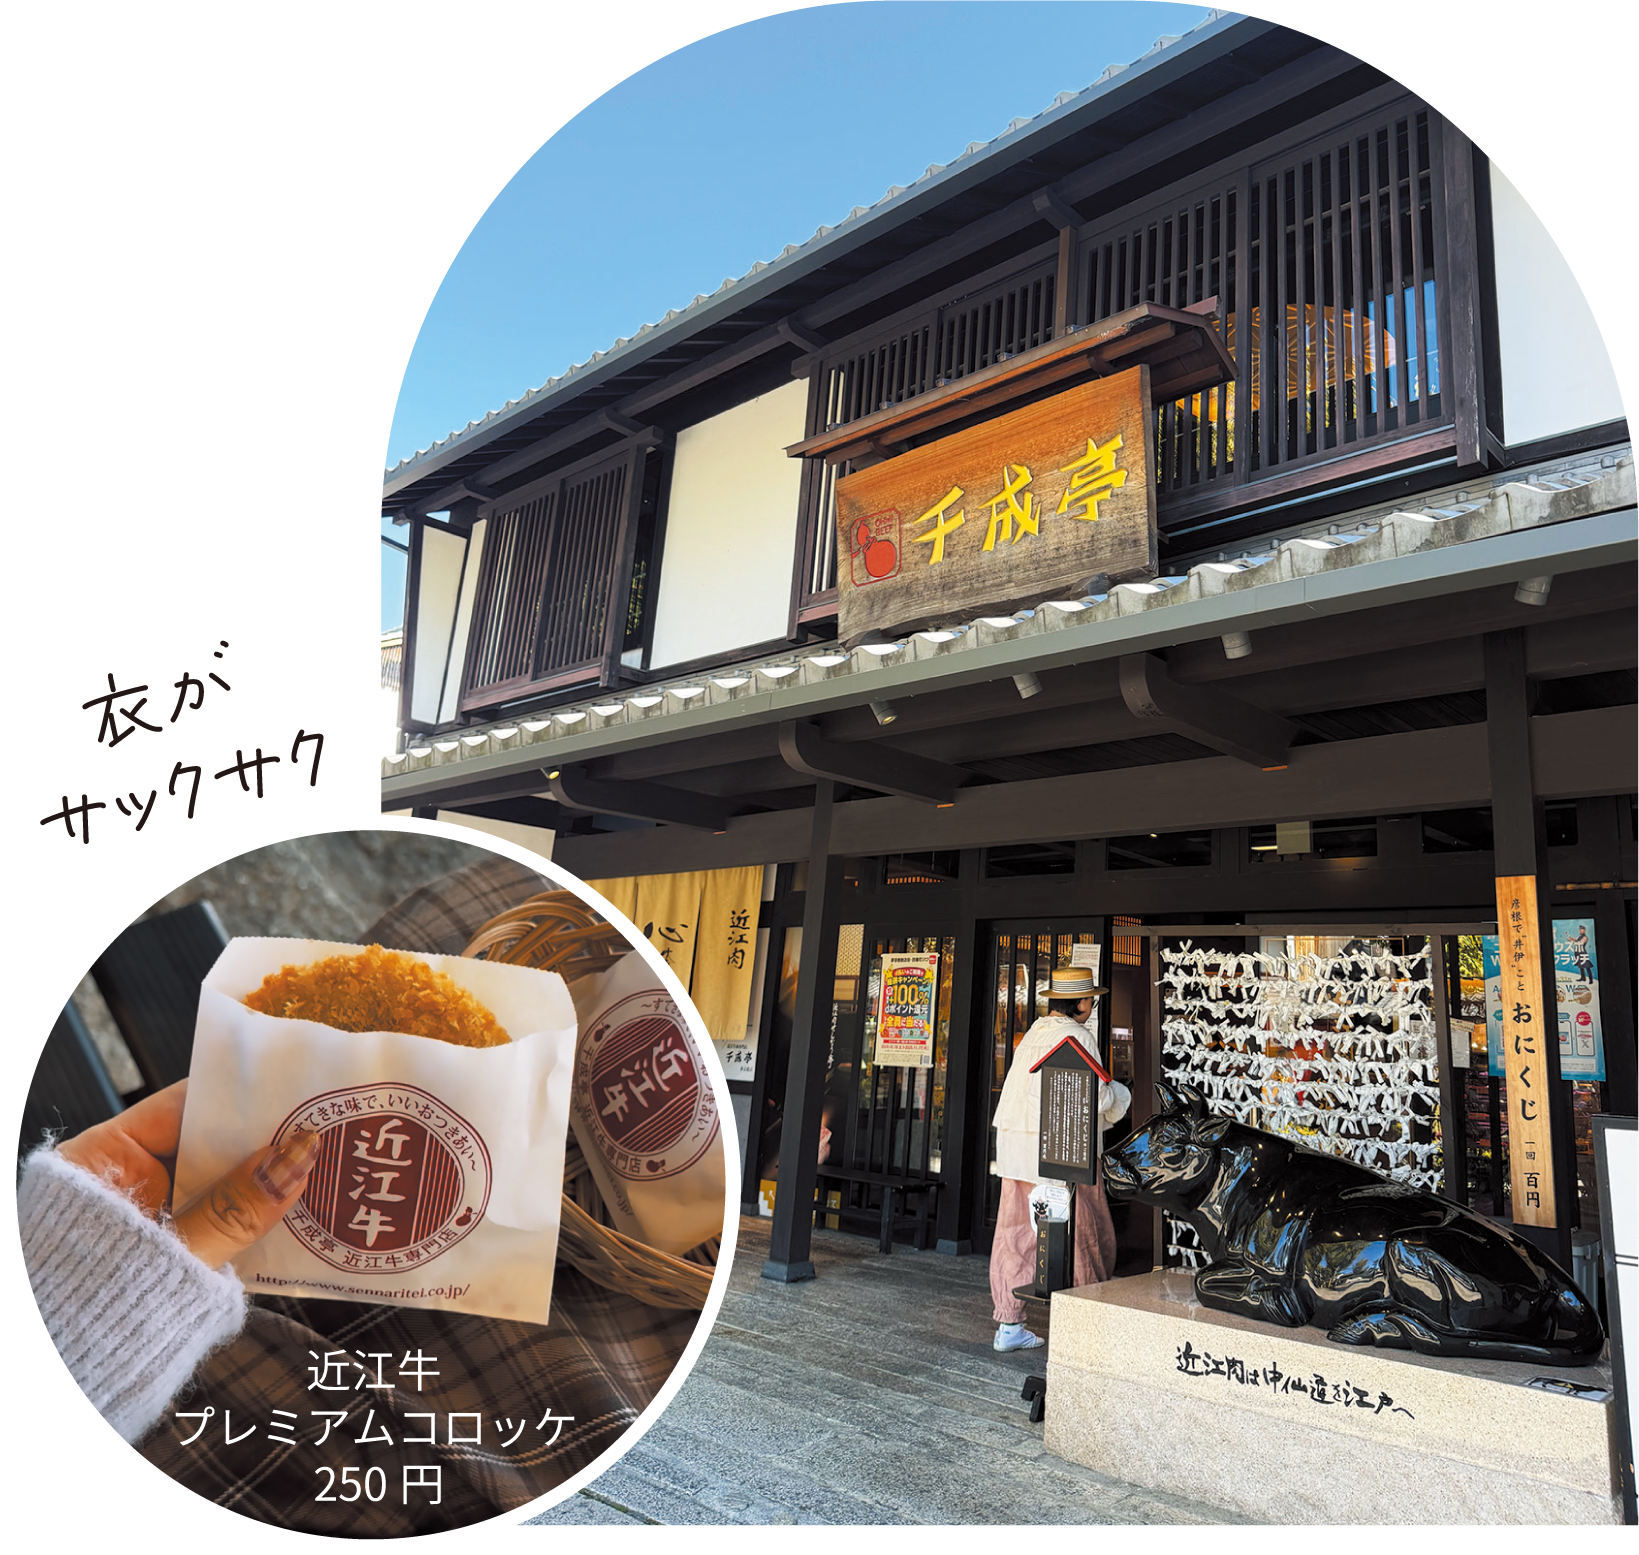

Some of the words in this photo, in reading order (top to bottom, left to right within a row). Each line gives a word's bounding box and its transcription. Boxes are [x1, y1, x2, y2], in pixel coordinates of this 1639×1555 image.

[910, 433, 1128, 566] 千成亭
[876, 523, 894, 537] BEEF
[727, 908, 751, 970] 近江肉
[601, 1036, 689, 1123] 近江牛
[1512, 1002, 1537, 1121] おにくじ
[1524, 1142, 1536, 1161] 一回
[348, 1118, 412, 1248] 近江牛
[1523, 1172, 1541, 1209] 百円
[290, 1209, 339, 1254] 千成亭
[342, 1228, 459, 1269] 近江牛専門店
[1039, 1229, 1047, 1284] おにくじ
[255, 1272, 471, 1299] http://www.sennaritei.co.jp/
